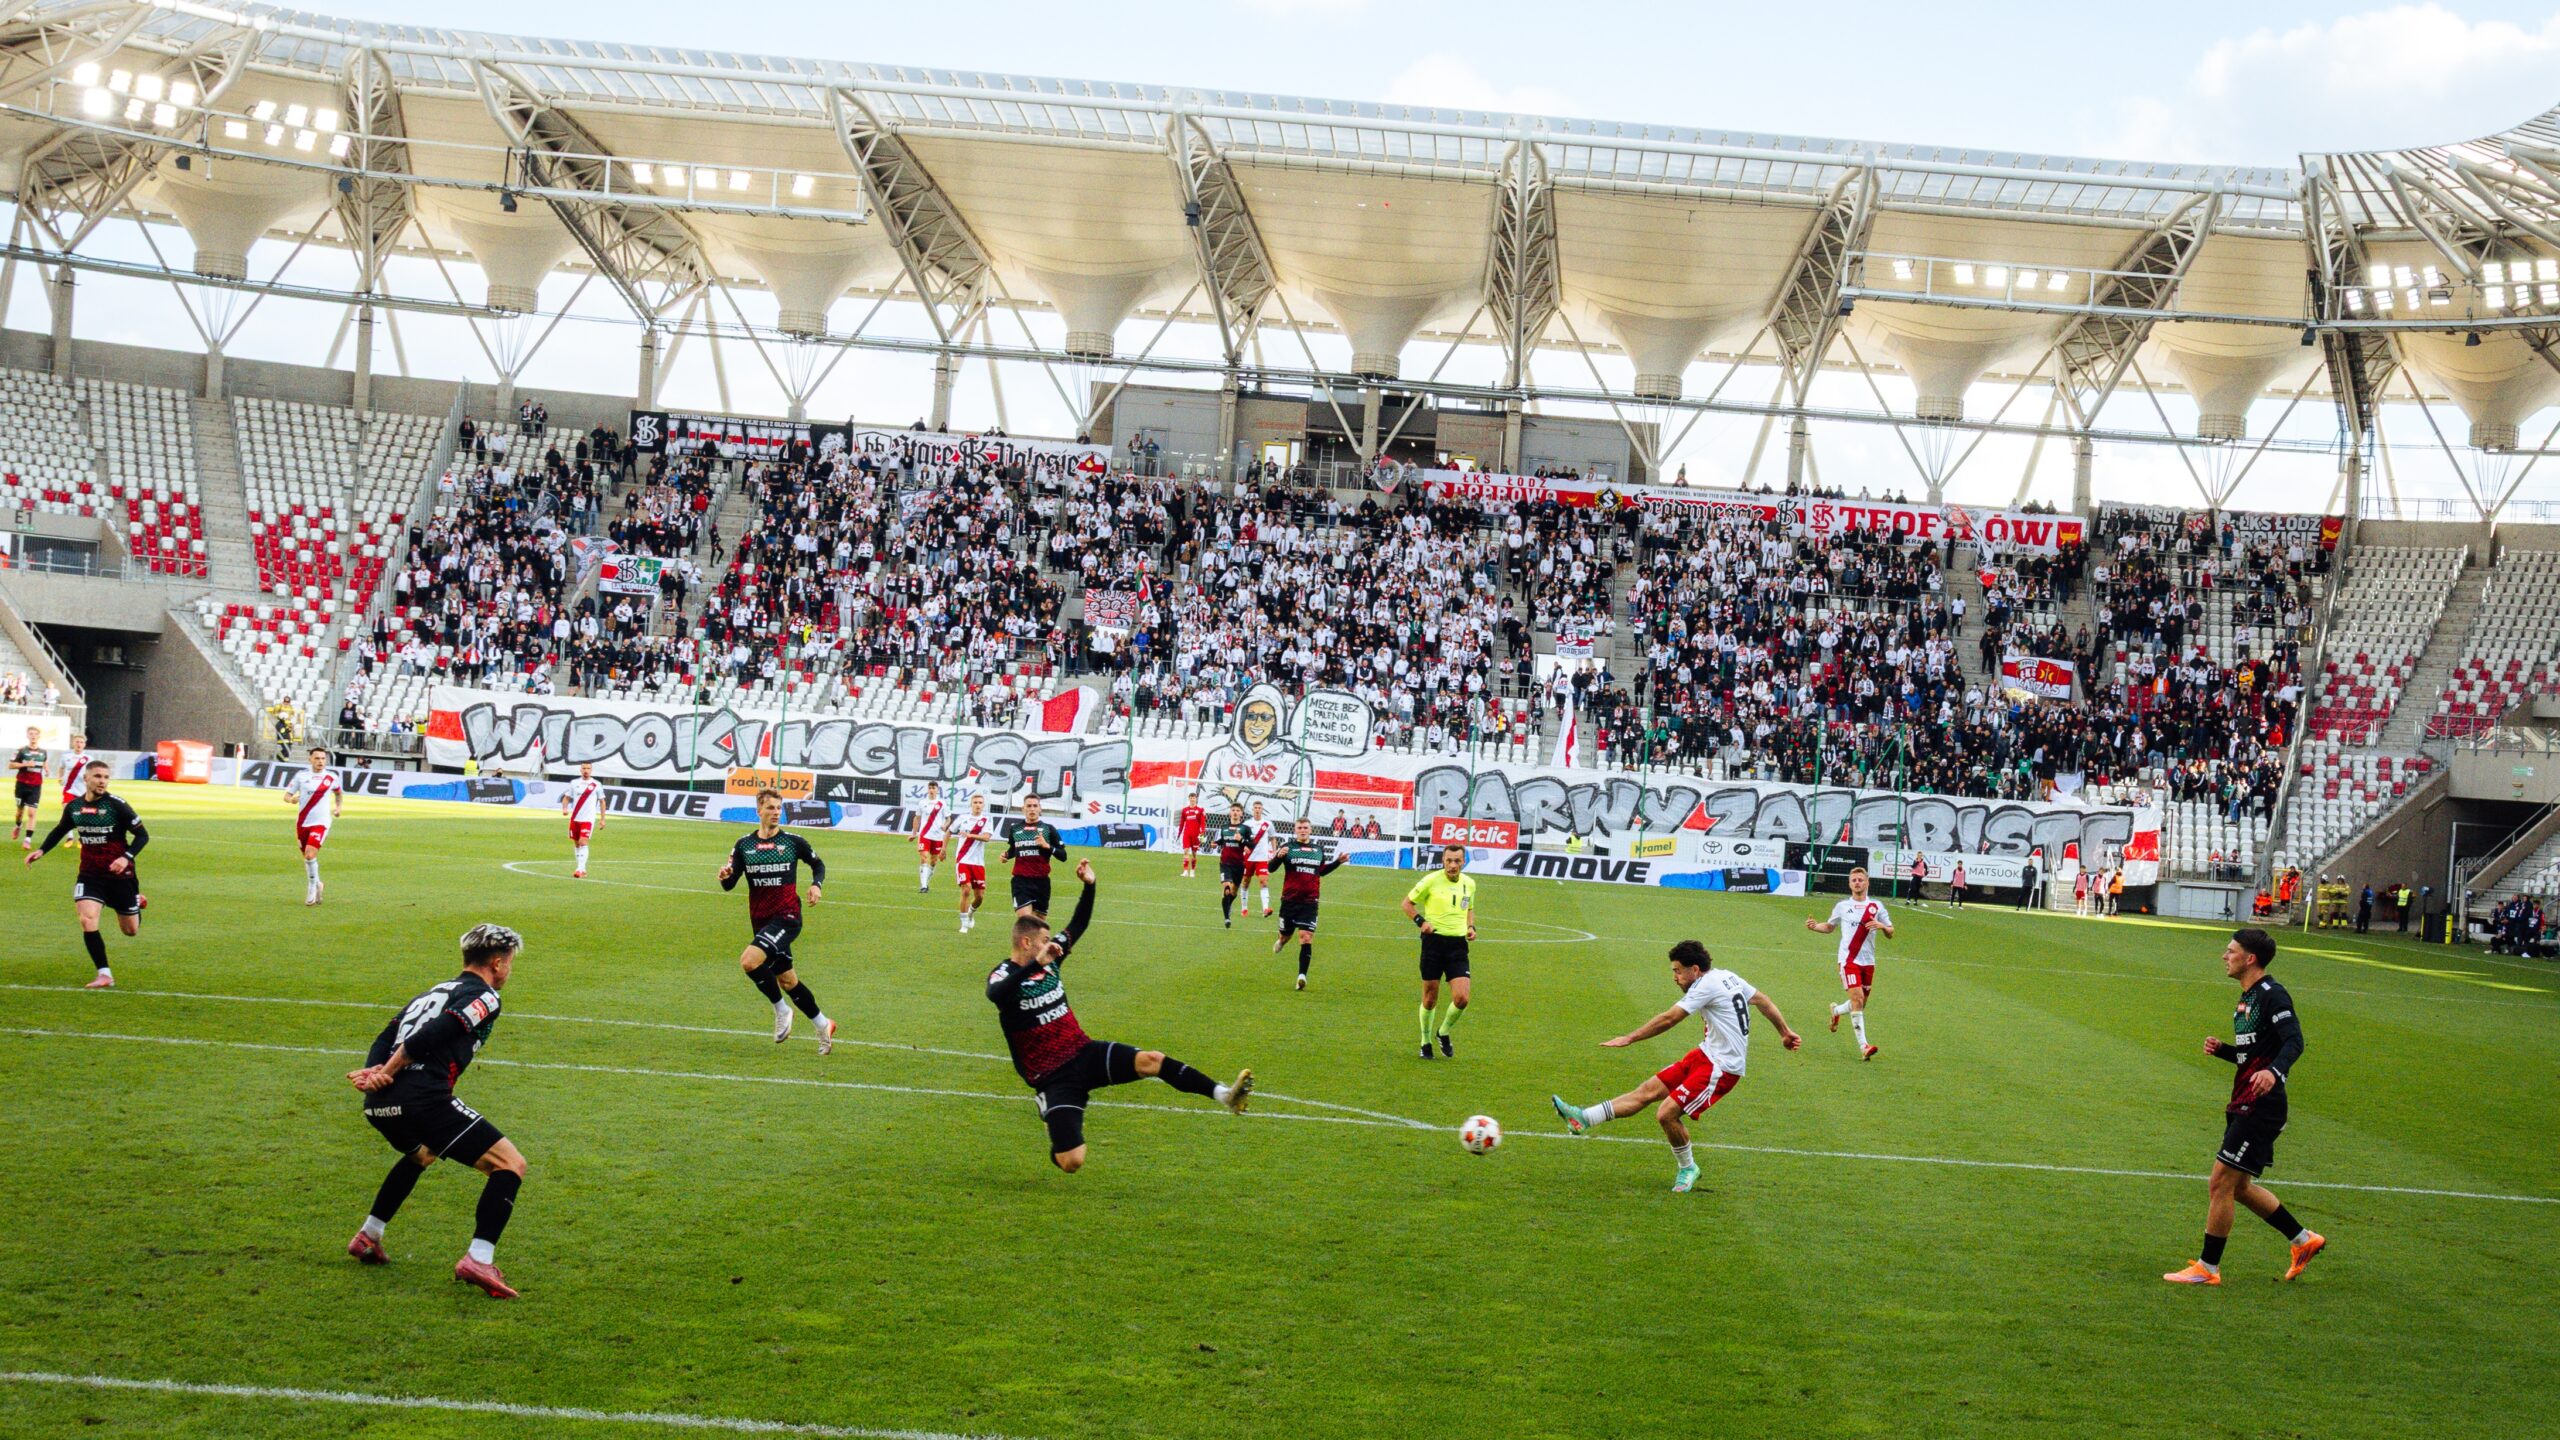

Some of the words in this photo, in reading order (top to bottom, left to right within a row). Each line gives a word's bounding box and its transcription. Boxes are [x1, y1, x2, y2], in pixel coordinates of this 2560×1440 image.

[1462, 473, 1492, 485] ŁKS
[15, 509, 33, 525] E1
[2240, 515, 2272, 531] ŁKS
[1309, 698, 1338, 711] MECZE
[1341, 702, 1360, 713] BEZ
[1312, 710, 1350, 721] PALENIA
[1321, 722, 1339, 732] NIE
[1341, 723, 1356, 733] DO
[1303, 731, 1354, 746] ZNIESIENIA
[461, 701, 768, 773] WIDOKI
[771, 719, 1133, 798] MGLISTE
[241, 761, 394, 796] 4MVE
[1228, 763, 1278, 784] GWS
[731, 776, 767, 790] radio
[557, 787, 711, 818] MOVE
[1415, 764, 1702, 838] BARWY
[1104, 803, 1166, 818] SUZUKI
[1441, 822, 1509, 844] Betclic
[1103, 839, 1145, 849] 4MOVE
[1884, 852, 1951, 867] COSNUS
[745, 862, 791, 874] SUPERBET
[1500, 851, 1651, 884] 4MOVE
[1968, 866, 2024, 878] MATSUOK
[752, 877, 783, 887] TYSKIE
[1727, 883, 1768, 893] 4MOVE
